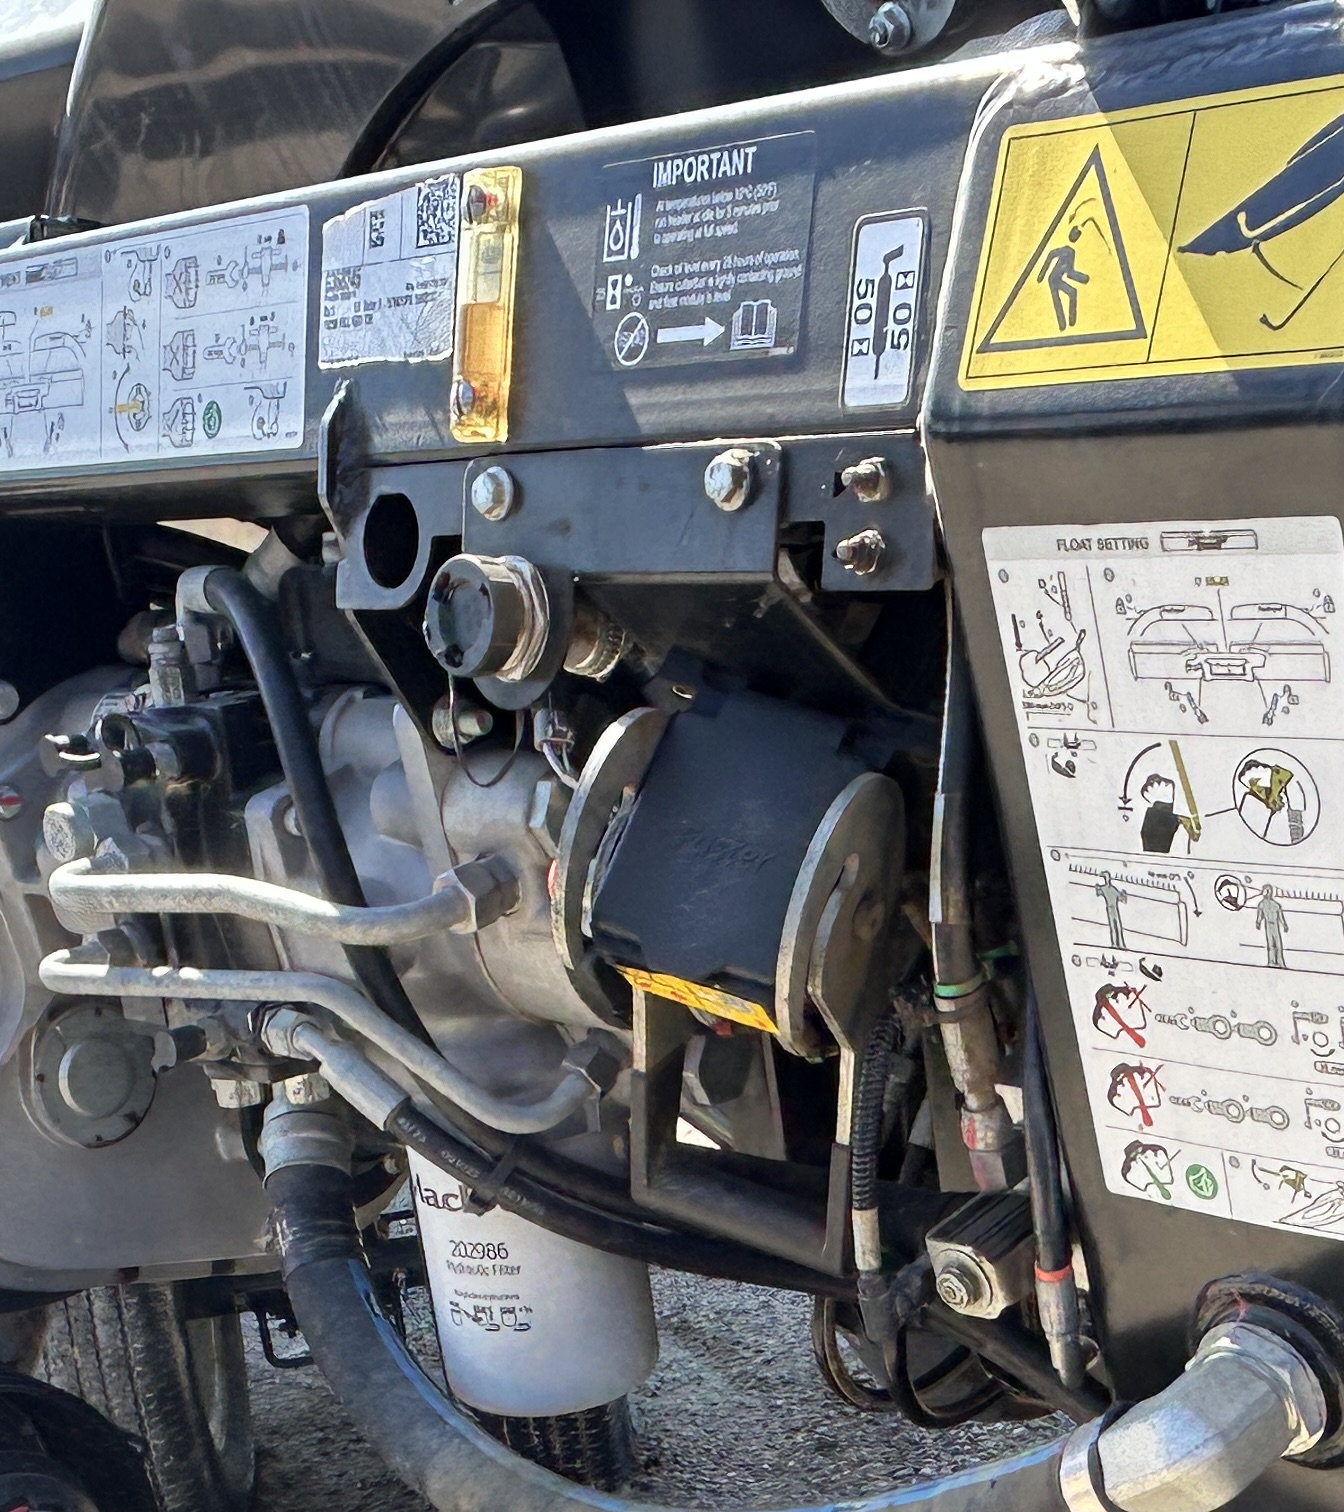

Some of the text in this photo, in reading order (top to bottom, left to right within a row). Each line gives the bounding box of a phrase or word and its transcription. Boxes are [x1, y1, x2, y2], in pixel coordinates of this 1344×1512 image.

[653, 146, 757, 188] IMPORTANT
[854, 278, 875, 325] 50
[890, 302, 912, 350] 50
[1056, 537, 1149, 552] FLOAT SETTING
[449, 1240, 509, 1260] 202986
